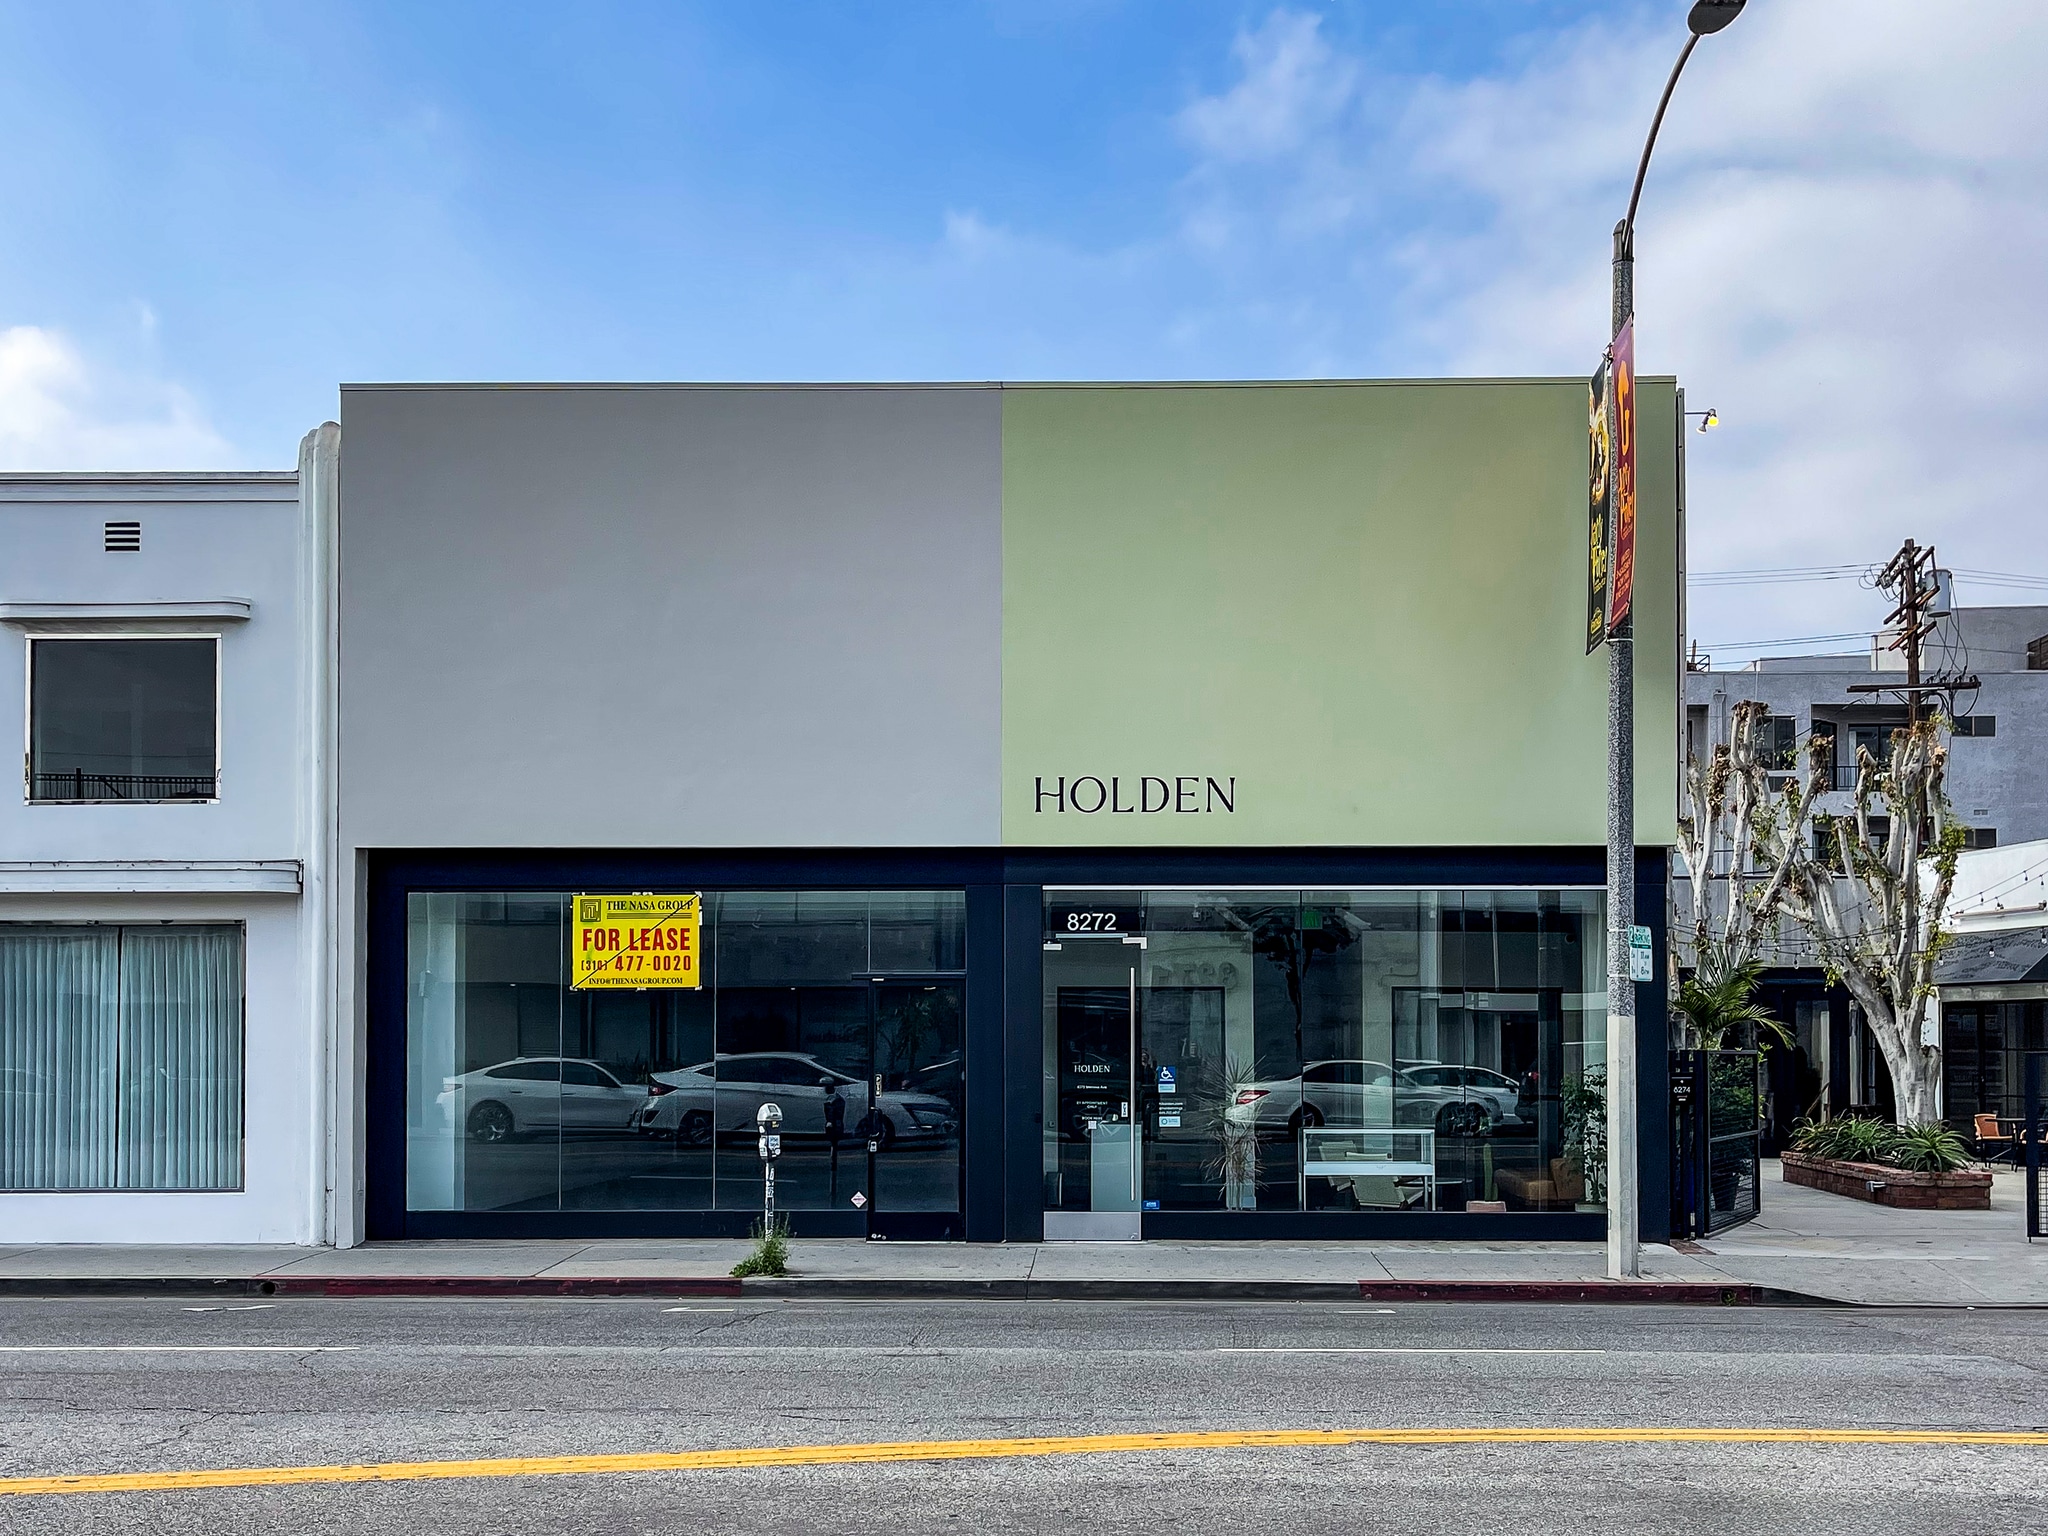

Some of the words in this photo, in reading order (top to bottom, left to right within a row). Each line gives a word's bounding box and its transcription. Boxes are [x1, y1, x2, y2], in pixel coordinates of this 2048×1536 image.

[1034, 775, 1236, 814] HOLDEN
[606, 901, 627, 910] THE
[629, 900, 655, 910] NASA
[657, 900, 693, 911] GROUP
[1066, 913, 1117, 931] 8272
[582, 928, 620, 951] FOR
[629, 928, 691, 951] LEASE
[614, 955, 691, 971] 477-0020
[588, 977, 683, 985] INFO@THENASAGROUP.COM
[1074, 1064, 1111, 1073] HOLDEN
